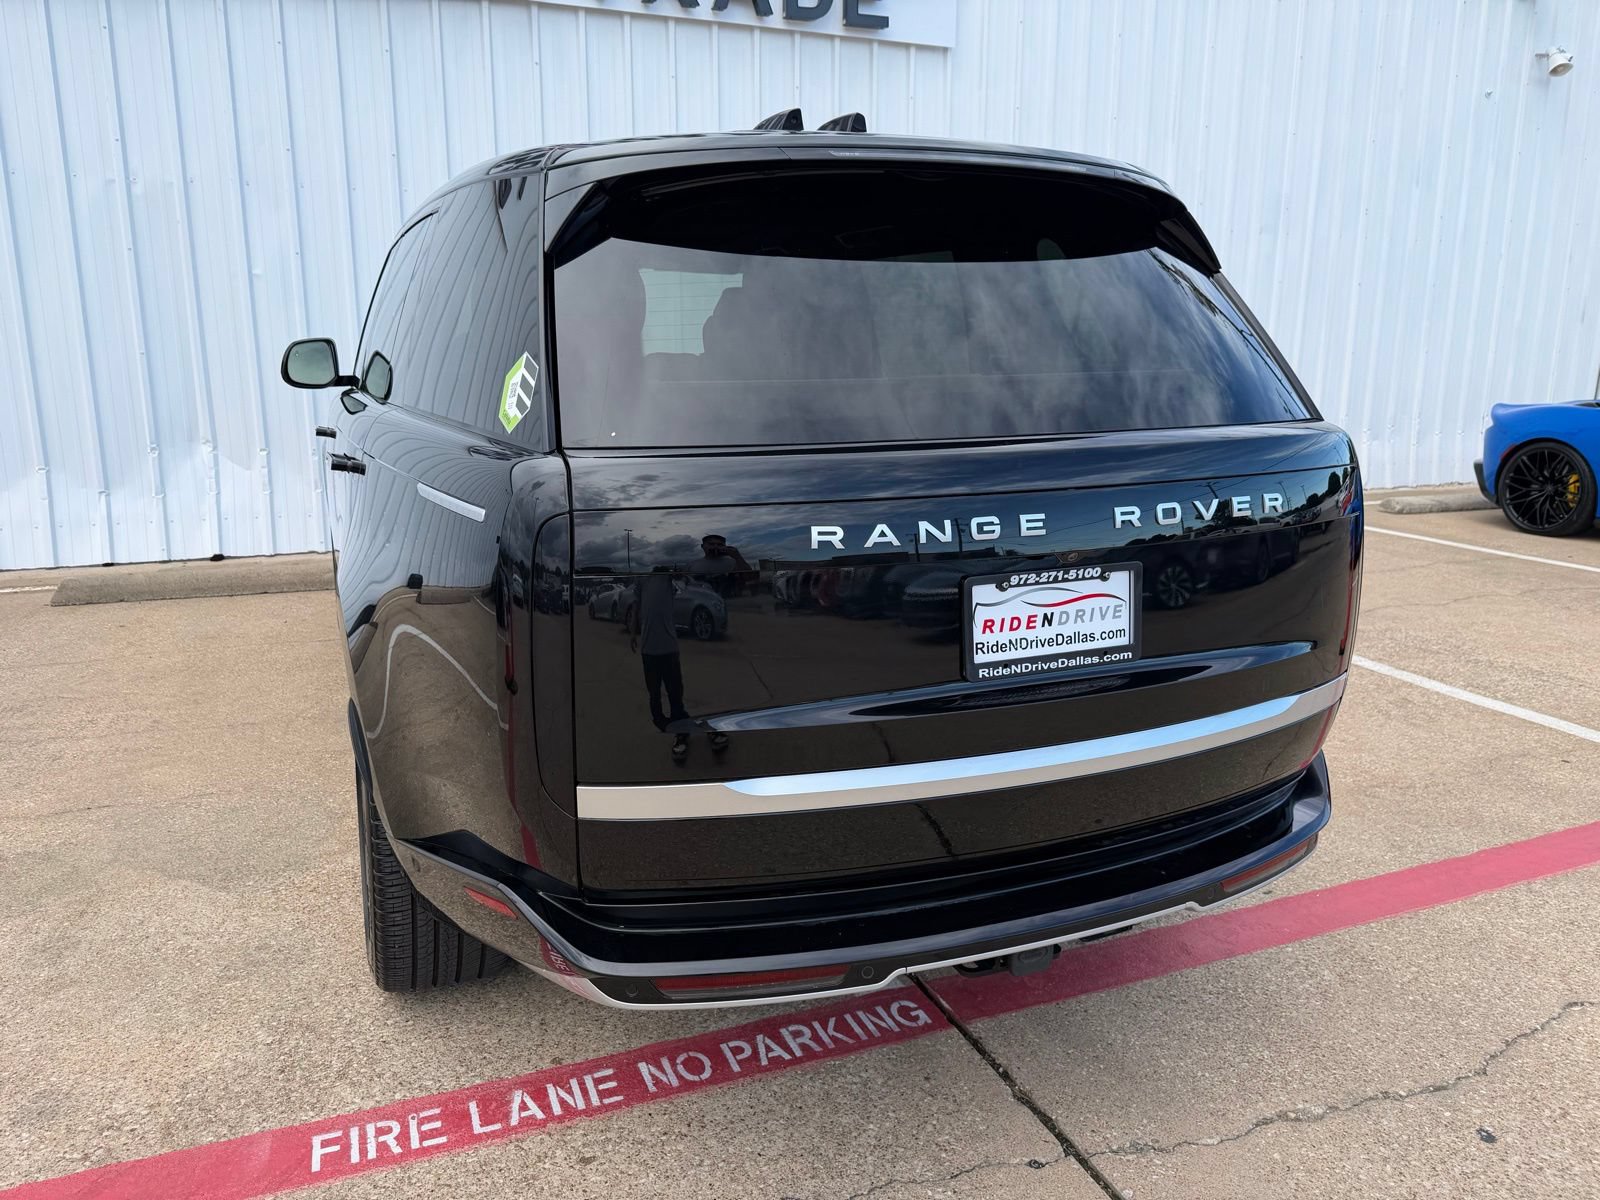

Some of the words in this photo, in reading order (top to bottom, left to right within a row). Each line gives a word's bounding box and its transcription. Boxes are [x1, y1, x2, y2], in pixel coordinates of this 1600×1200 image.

[810, 512, 1048, 550] RANGE
[1113, 492, 1285, 529] ROVER
[1010, 567, 1102, 586] 972-271-5100
[975, 627, 1126, 656] RideNDriveDallas.com
[978, 651, 1133, 679] RideNDriveDallas.com
[311, 1107, 448, 1173] FIRE
[468, 1068, 625, 1135] LANE
[637, 1051, 712, 1093] NO
[718, 999, 933, 1073] PARKING
